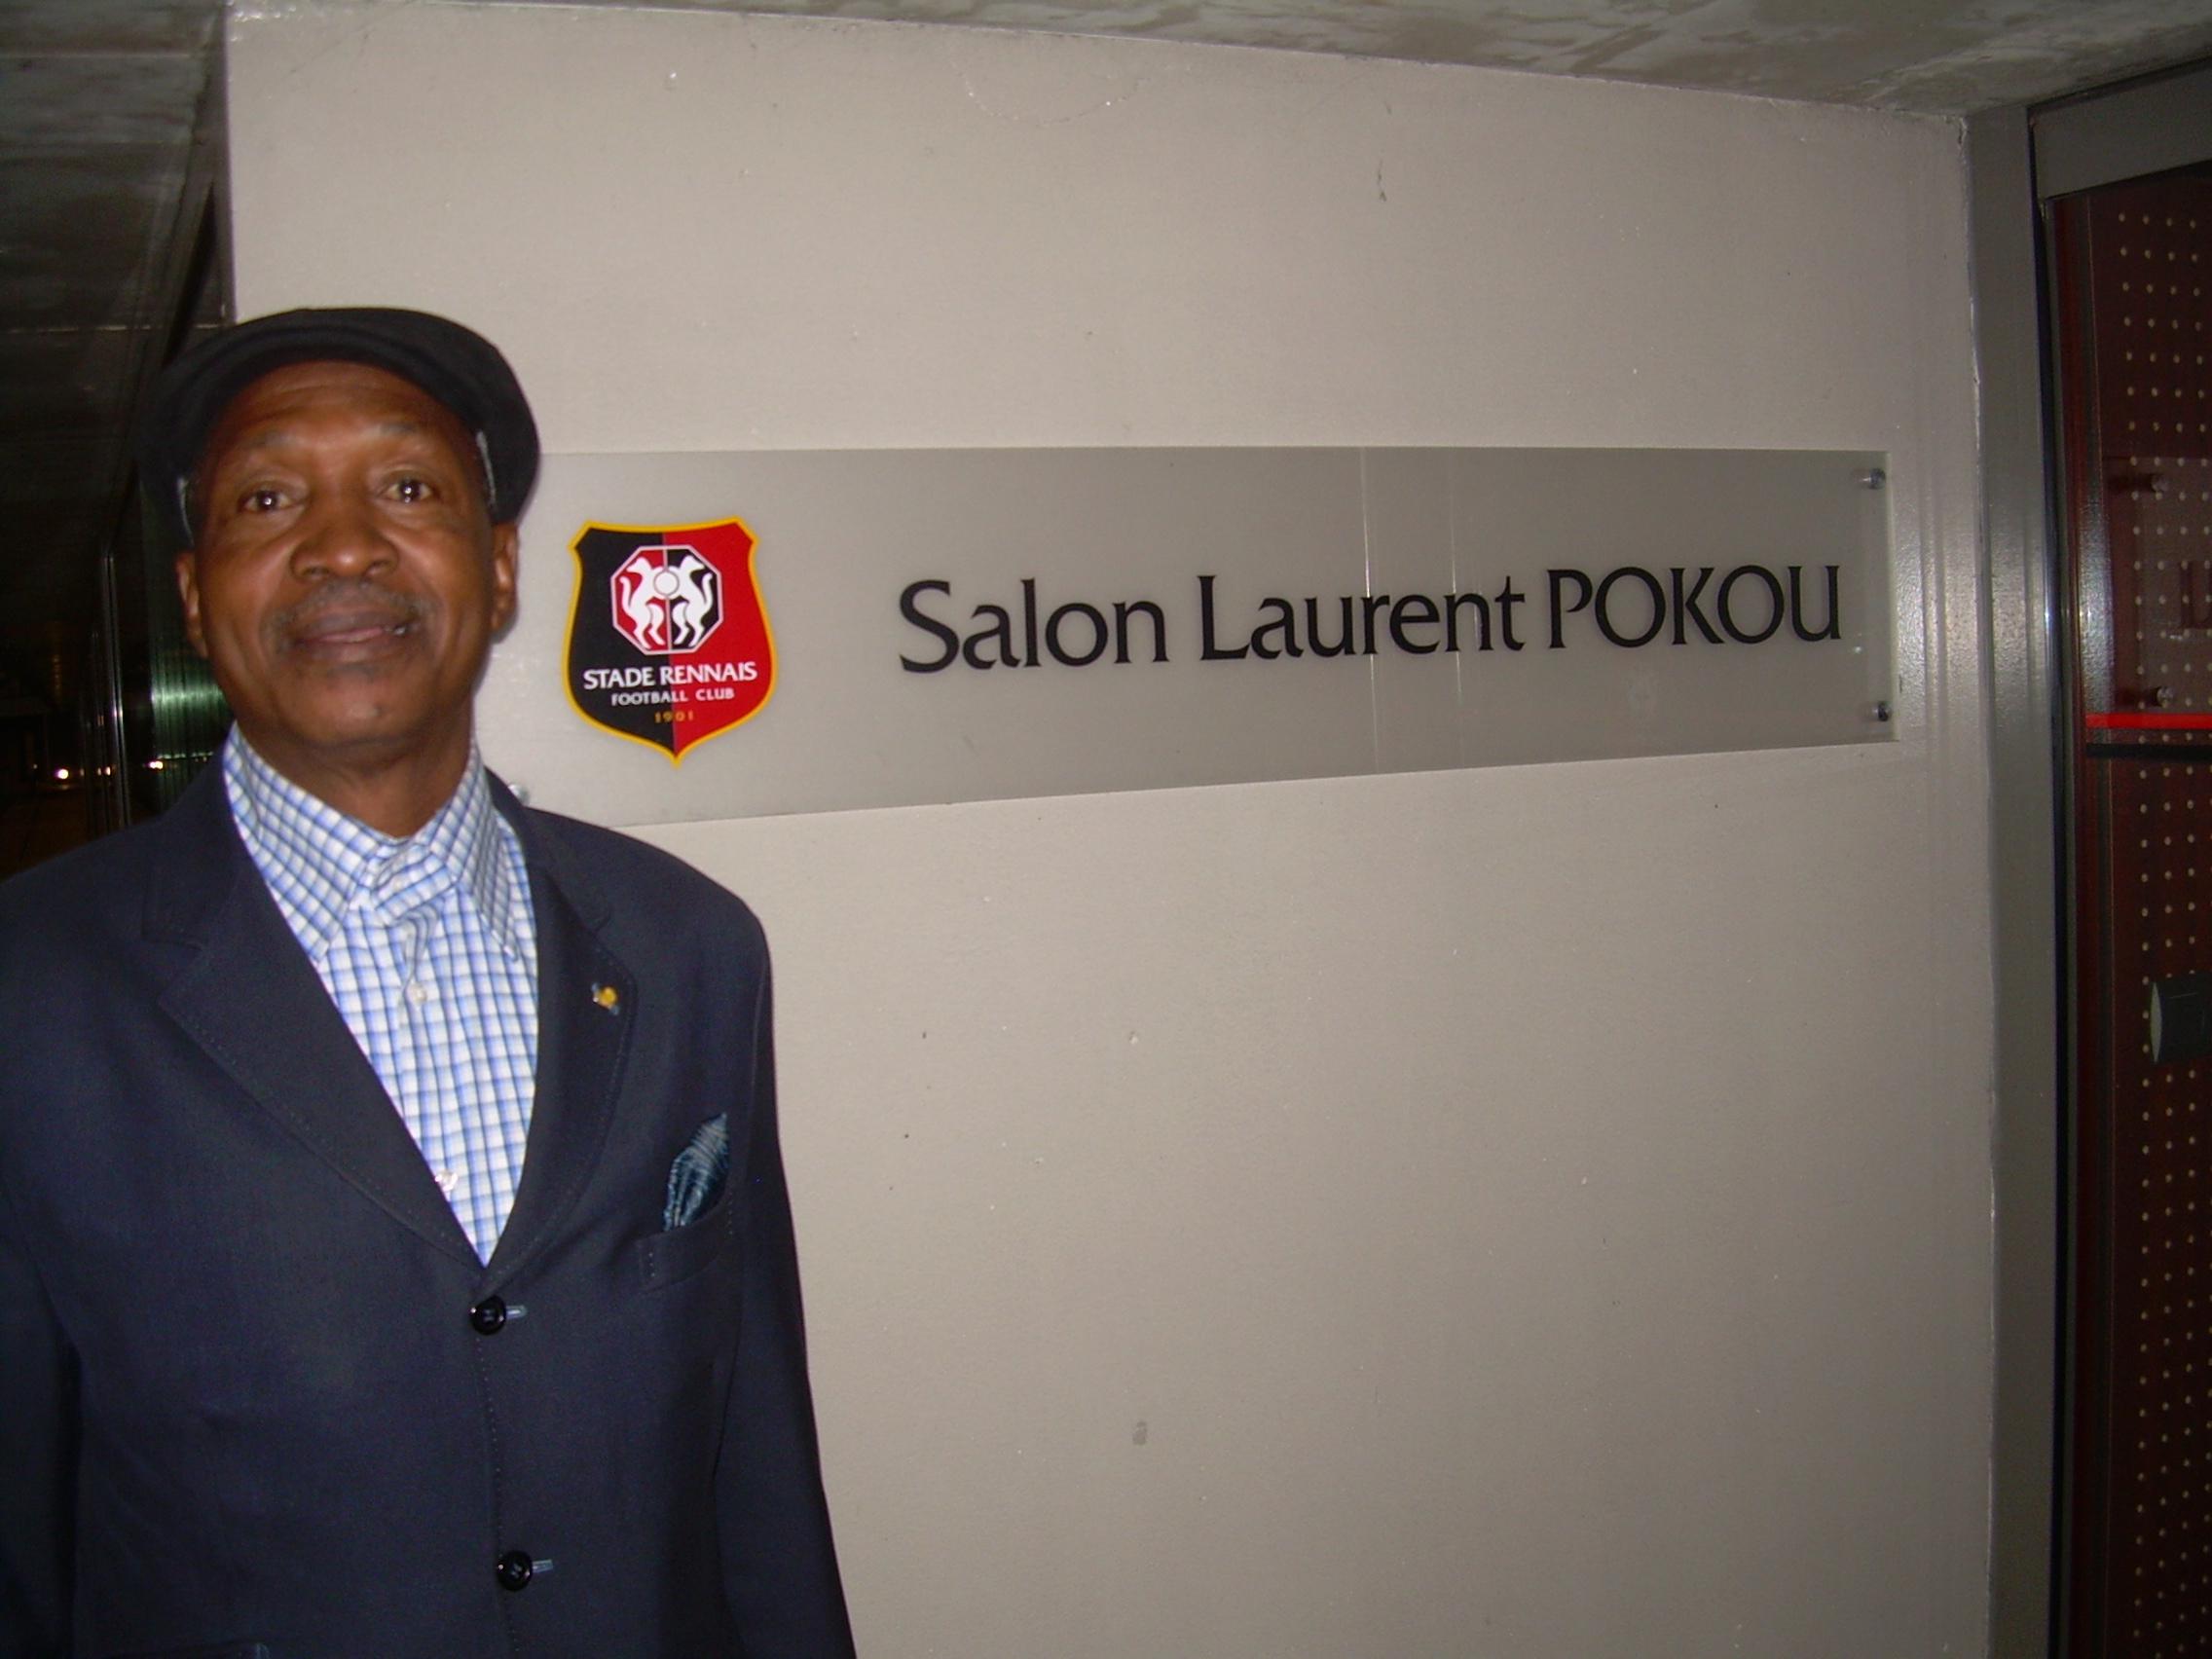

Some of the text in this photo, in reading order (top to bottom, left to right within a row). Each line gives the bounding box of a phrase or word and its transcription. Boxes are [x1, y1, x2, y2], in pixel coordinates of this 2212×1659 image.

[901, 565, 1842, 674] Salon Laurent POKOU
[583, 661, 757, 690] STADE RENNAIS
[611, 688, 735, 706] FOOTBALL CLUB
[654, 710, 694, 723] 1901
